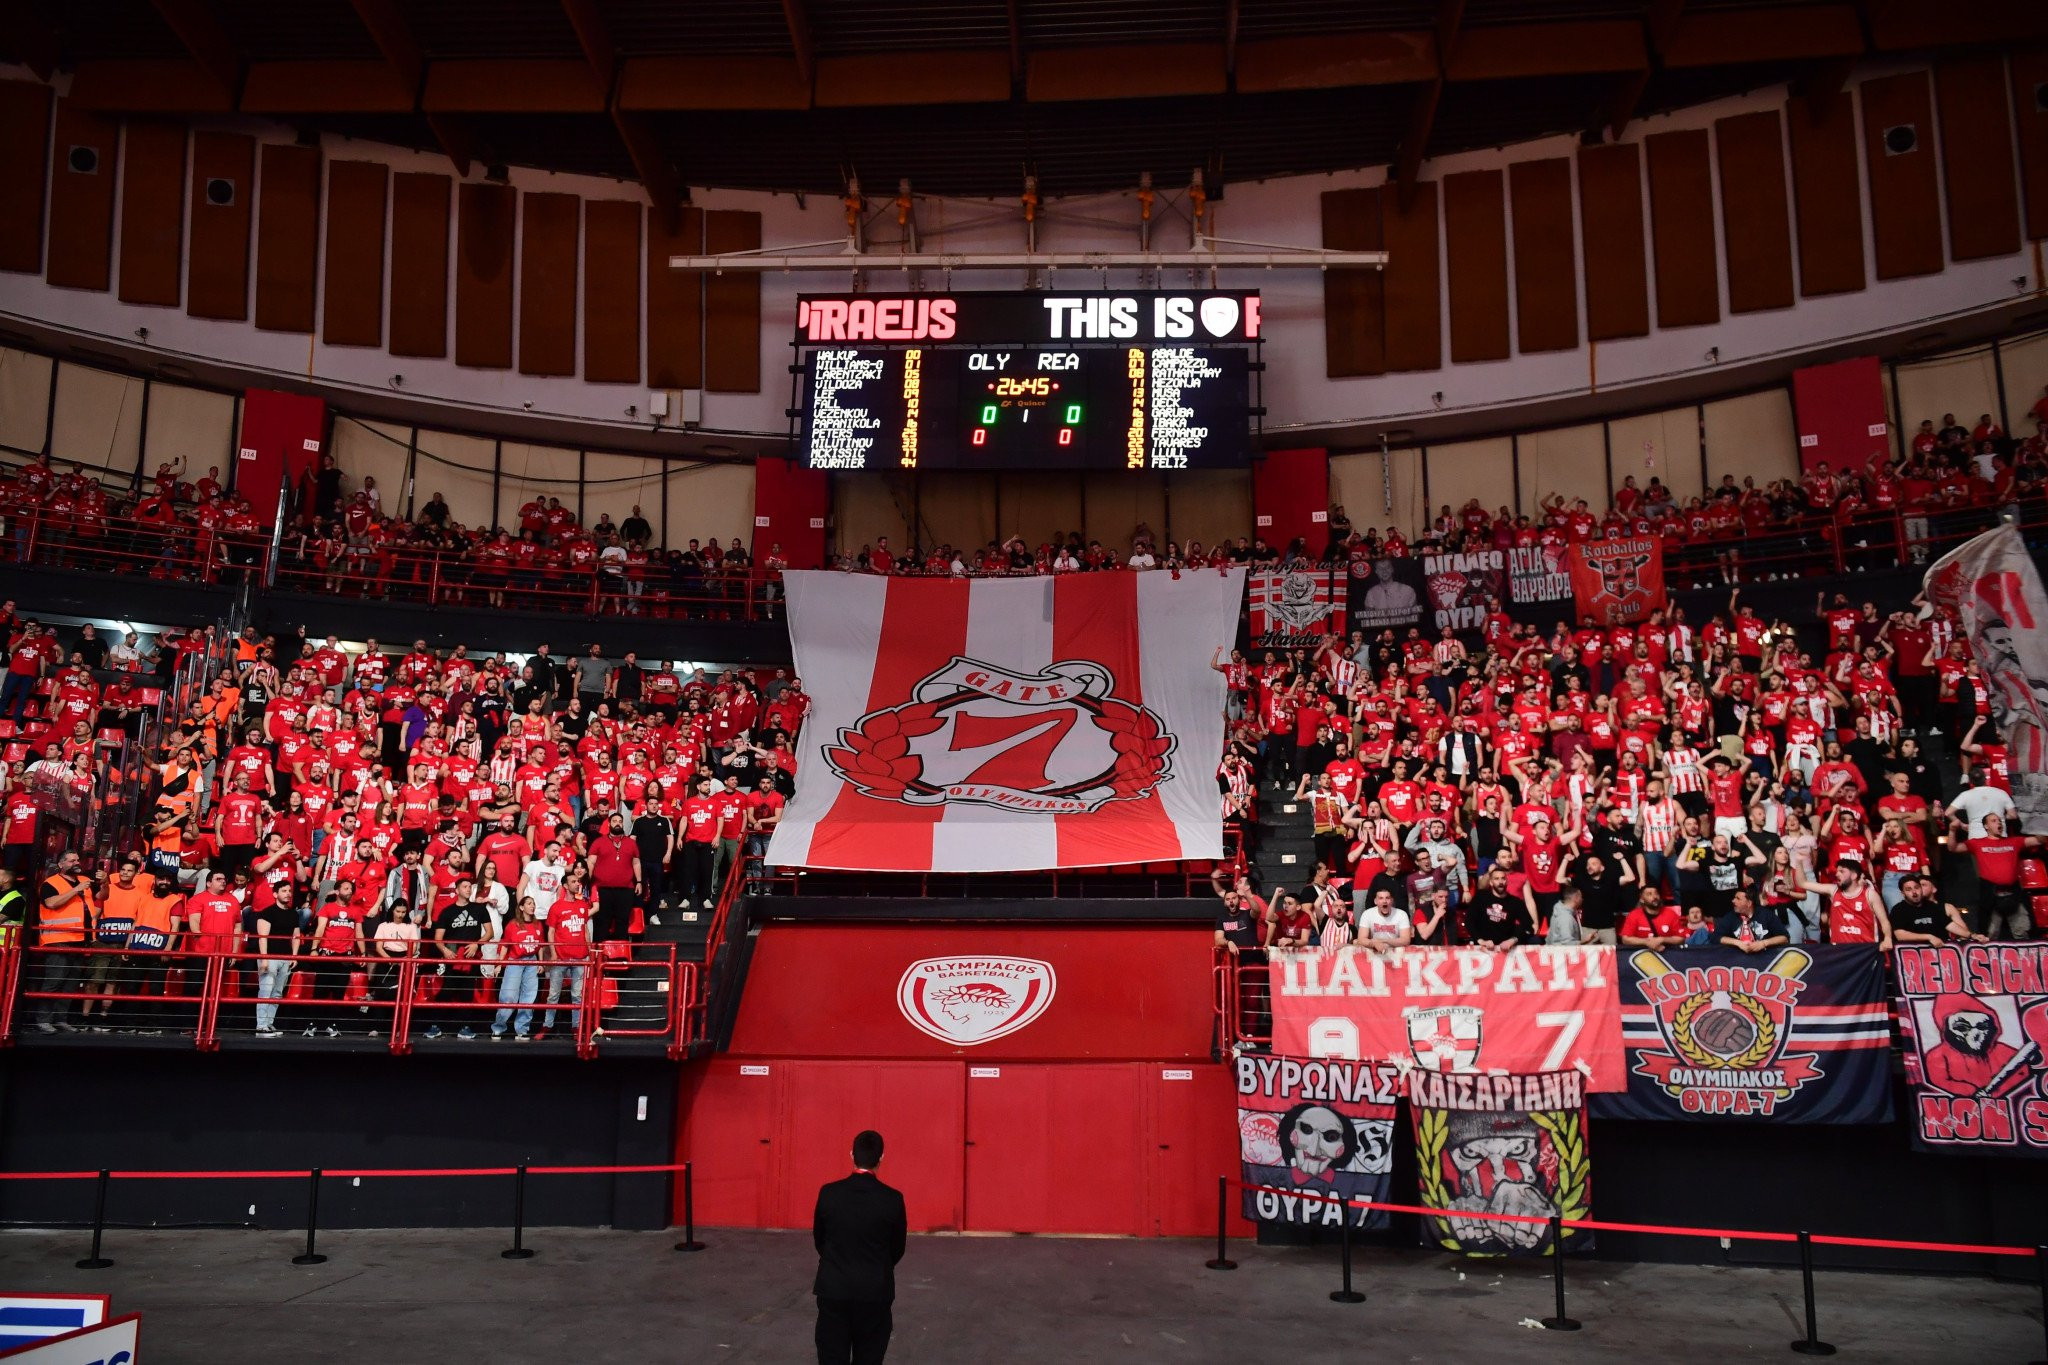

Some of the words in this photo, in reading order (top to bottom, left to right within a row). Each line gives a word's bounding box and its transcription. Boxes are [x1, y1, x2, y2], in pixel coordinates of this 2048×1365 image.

[1044, 298, 1138, 338] THIS
[1154, 298, 1194, 338] IS
[817, 351, 858, 361] WALKUP
[906, 350, 921, 360] 00
[1129, 349, 1144, 359] 06
[1152, 349, 1194, 359] ABALDE
[816, 361, 884, 371] WILLIAMS-G
[905, 360, 920, 369] 01
[968, 354, 1010, 370] OLY
[1038, 353, 1080, 370] REA
[1129, 358, 1144, 368] 07
[1152, 359, 1208, 369] CAMPAZZO
[815, 370, 882, 380] LARENTZAKI
[904, 370, 920, 379] 05
[1129, 368, 1144, 378] 08
[1152, 368, 1221, 379] RATHAN-MAY
[815, 380, 863, 390] VILDOZA
[904, 379, 920, 389] 08
[997, 378, 1050, 395] 26:45
[1133, 378, 1144, 388] 11
[1152, 378, 1201, 388] HEZONJA
[814, 390, 835, 400] LEE
[903, 389, 919, 399] 09
[1152, 388, 1180, 398] MUSA
[813, 400, 841, 409] FALL
[1152, 398, 1180, 408] DECK
[813, 409, 868, 419] VEZENKOV
[982, 406, 997, 423] 0
[1023, 409, 1029, 423] 1
[1066, 406, 1080, 423] 0
[1152, 408, 1194, 418] GARUBA
[812, 419, 881, 429] PAPANIKOLA
[1152, 418, 1187, 428] IBAKA
[812, 429, 853, 439] PETERS
[973, 429, 985, 444] 0
[1059, 429, 1071, 444] 0
[1128, 428, 1144, 438] 20
[1152, 428, 1208, 438] FERNANDO
[811, 438, 873, 448] MILUTINOV
[1152, 438, 1201, 448] TAVARES
[810, 448, 865, 458] MCKISSIC
[1128, 448, 1144, 458] 23
[1152, 448, 1187, 458] LLULL
[810, 458, 865, 468] FOURNIER
[901, 458, 916, 468] 94
[1152, 458, 1188, 468] FELIZ
[1508, 546, 1544, 575] ΑΓΙΑ
[1512, 572, 1573, 603] ΒΑΡΒΑΡΑ
[1258, 629, 1340, 647] Haidai
[965, 671, 1071, 702] GATE
[948, 708, 1078, 790] 7
[949, 786, 1088, 812] OLYMPIAKOS
[924, 962, 1038, 974] OLYMPIACOS
[1280, 947, 1607, 997] ΠΑΓΚΡΑΤΙ
[1901, 947, 1963, 994] RED
[938, 970, 1020, 980] BASKETBALL
[1637, 966, 1806, 1005] ΚΟΛΩΝΟΣ
[1536, 1010, 1585, 1072] 7
[1237, 1056, 1398, 1104] ΒΥΡΩΝΑΣ
[1669, 1069, 1786, 1088] ΟΛΥΜΠΙΑΚΟΣ
[1410, 1069, 1582, 1111] ΚΑΙΣΑΡΙΑΝΗ
[1680, 1089, 1776, 1115] ΘΥΡΑ-7
[1921, 1097, 2012, 1140] NON
[1256, 1185, 1345, 1226] ΘΥΡΑ
[1356, 1194, 1374, 1228] 7
